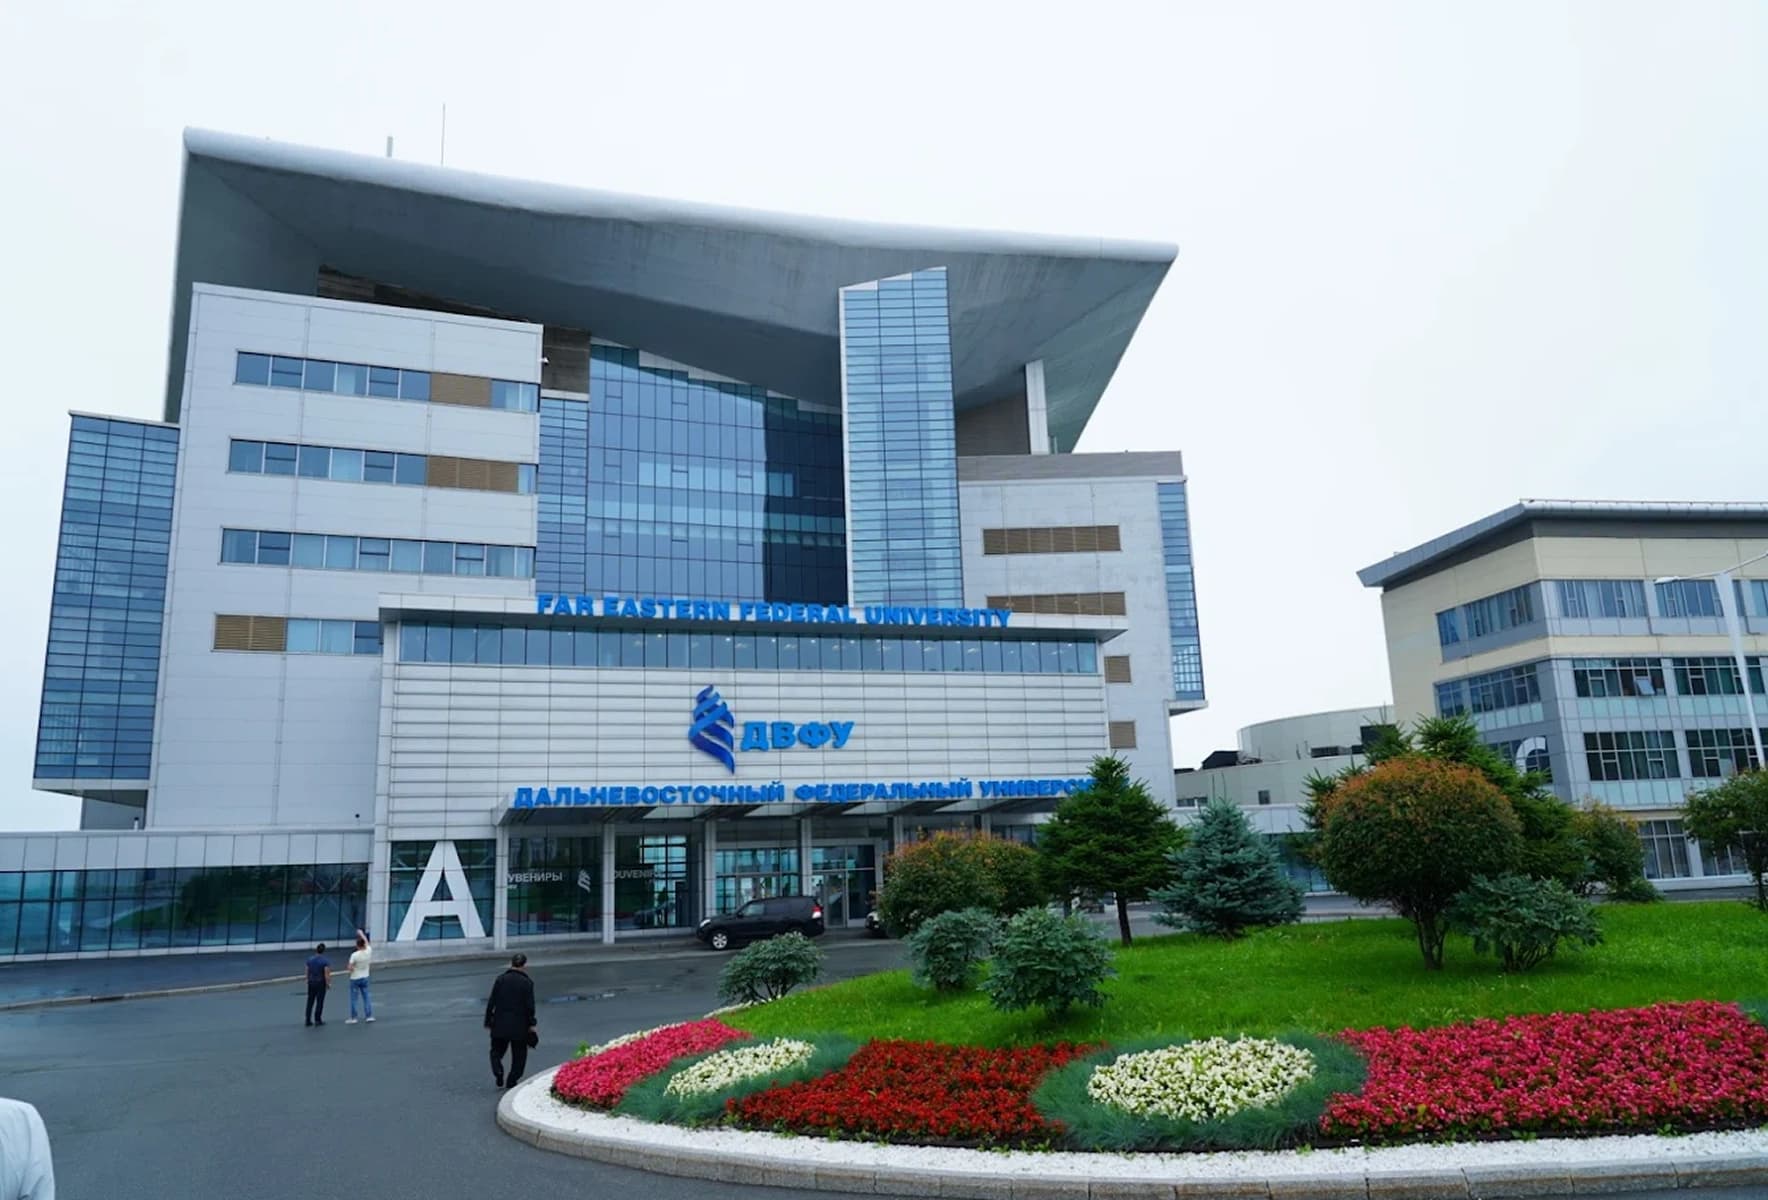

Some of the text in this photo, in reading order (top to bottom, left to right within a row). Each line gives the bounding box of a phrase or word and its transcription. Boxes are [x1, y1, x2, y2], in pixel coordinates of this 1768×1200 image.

[537, 594, 1011, 628] FAR EASTERN FEDERAL UNIVERSITY
[740, 721, 854, 751] ДВФУ
[514, 781, 785, 808] ДАЛЬНЕВОСТОЧНЫЙ
[793, 777, 973, 803] ФЕДЕРАЛЬНЫЙ
[395, 840, 486, 941] A
